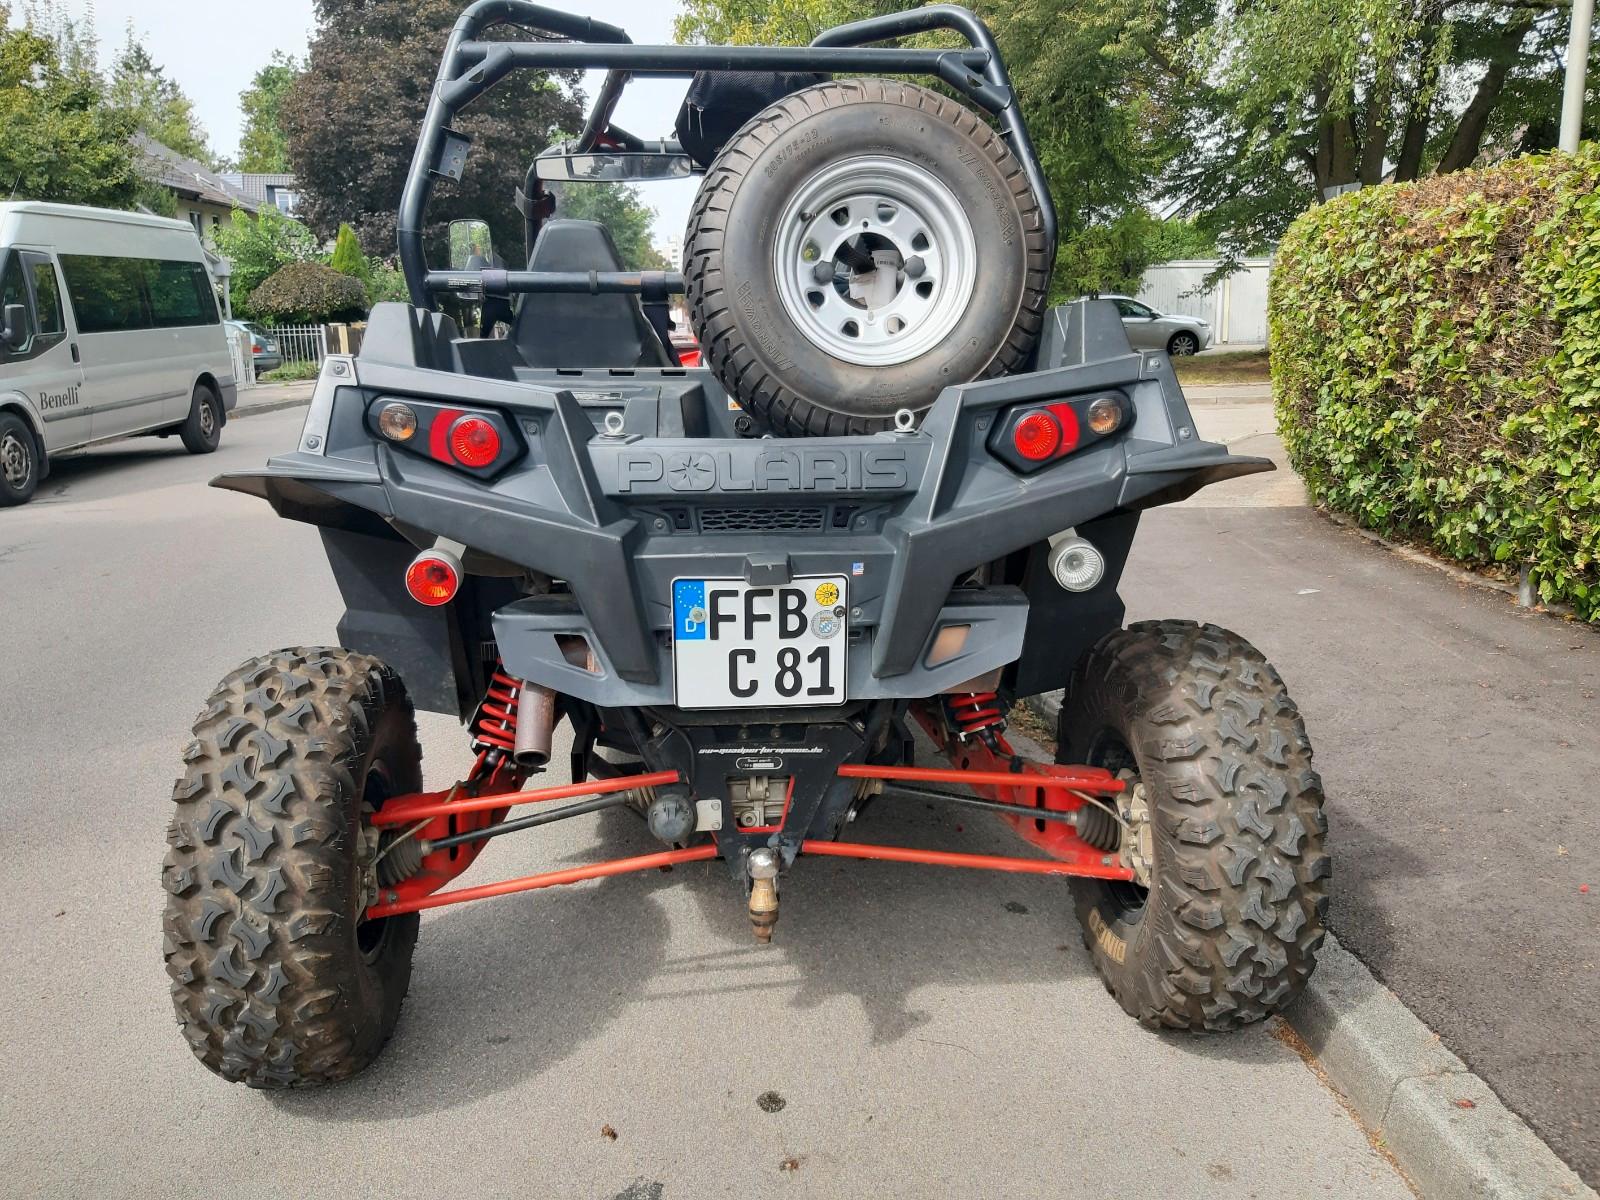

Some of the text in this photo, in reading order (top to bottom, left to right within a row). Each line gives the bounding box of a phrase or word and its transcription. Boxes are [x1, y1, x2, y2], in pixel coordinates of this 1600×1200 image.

[40, 386, 79, 410] Benelli
[618, 451, 908, 493] POLARIS
[685, 618, 698, 633] D
[709, 588, 808, 640] FFB
[728, 646, 835, 698] C 81
